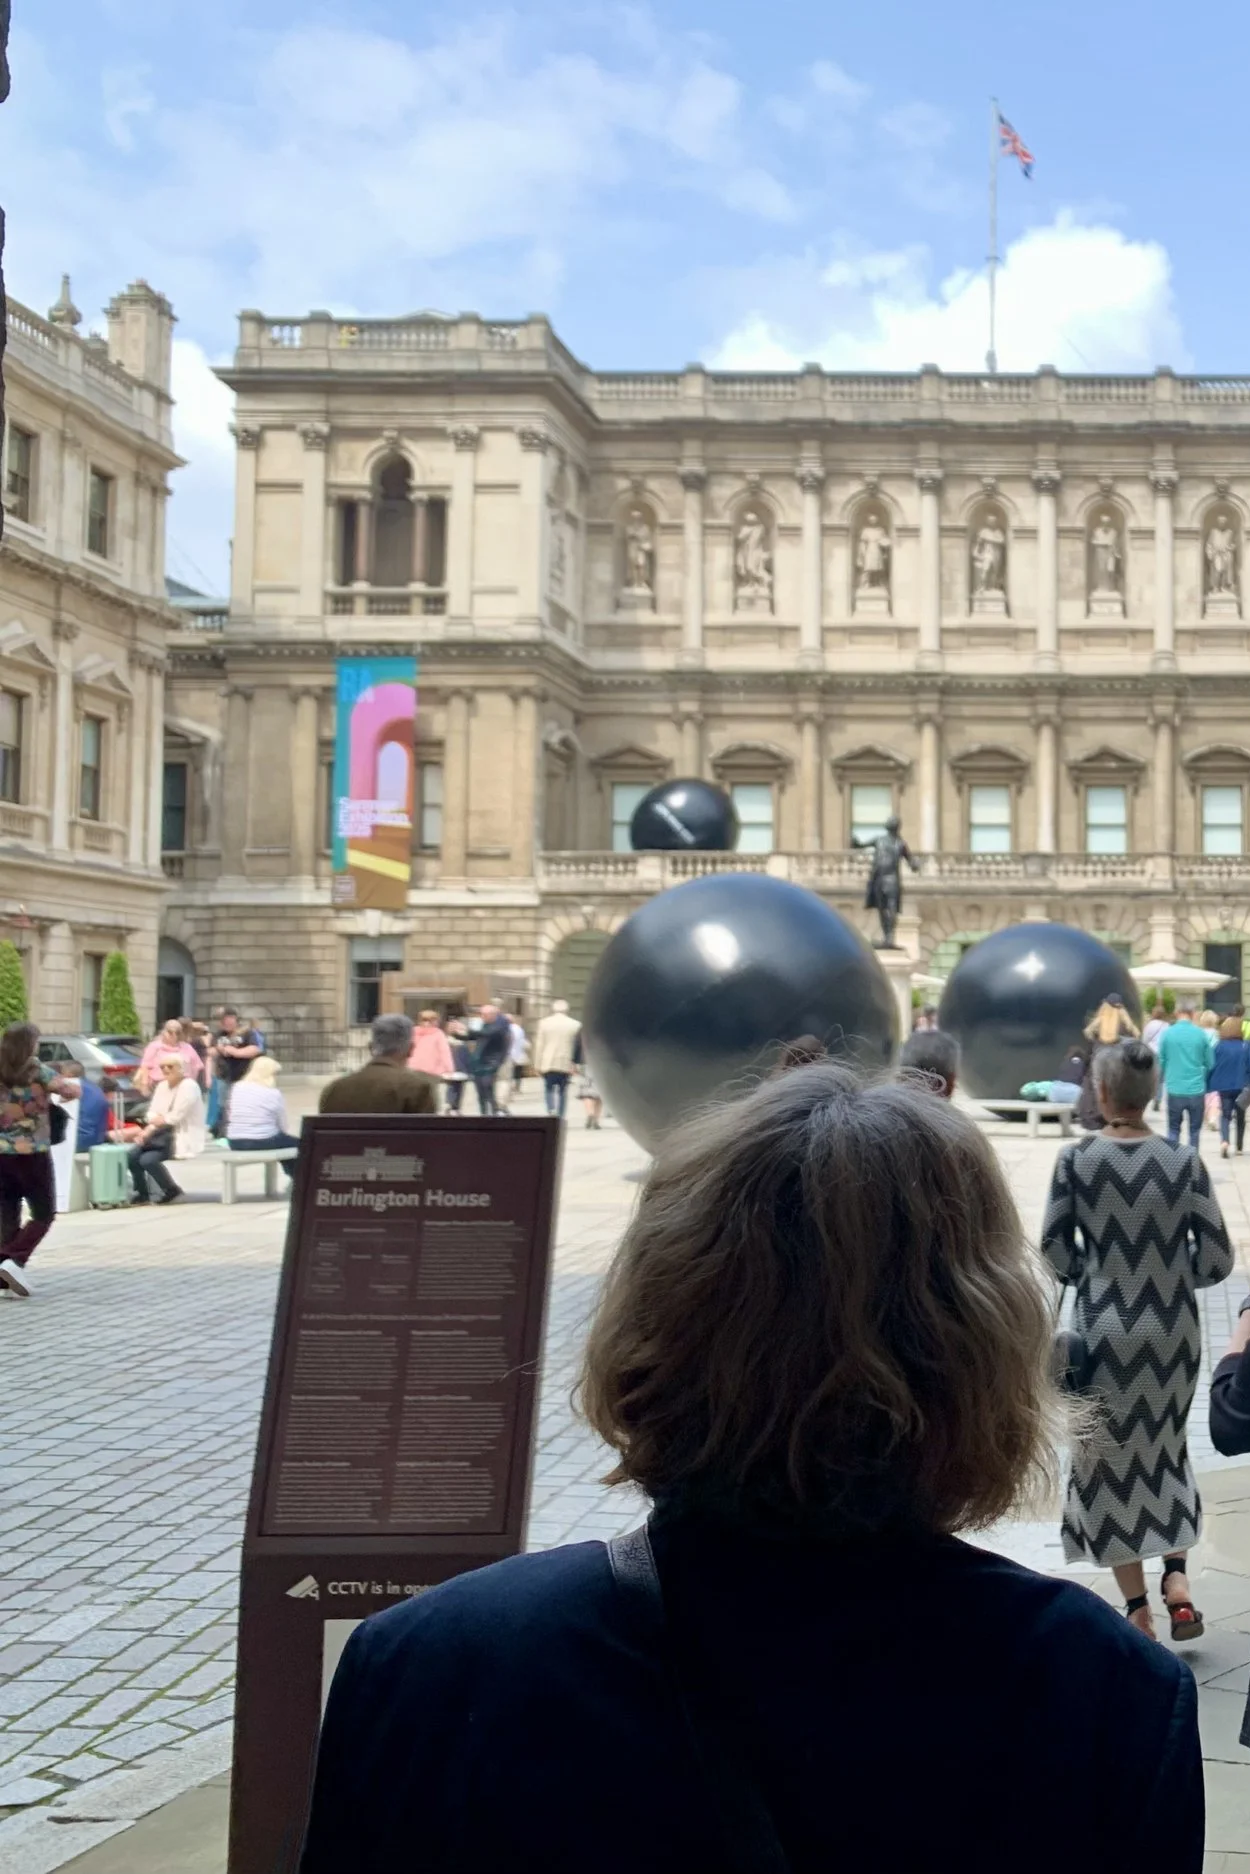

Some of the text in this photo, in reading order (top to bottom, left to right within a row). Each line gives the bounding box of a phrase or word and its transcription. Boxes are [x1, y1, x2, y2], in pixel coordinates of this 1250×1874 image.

[316, 1188, 491, 1212] Burlington House
[327, 1581, 368, 1595] CCTV
[370, 1581, 384, 1595] is
[387, 1581, 401, 1595] in
